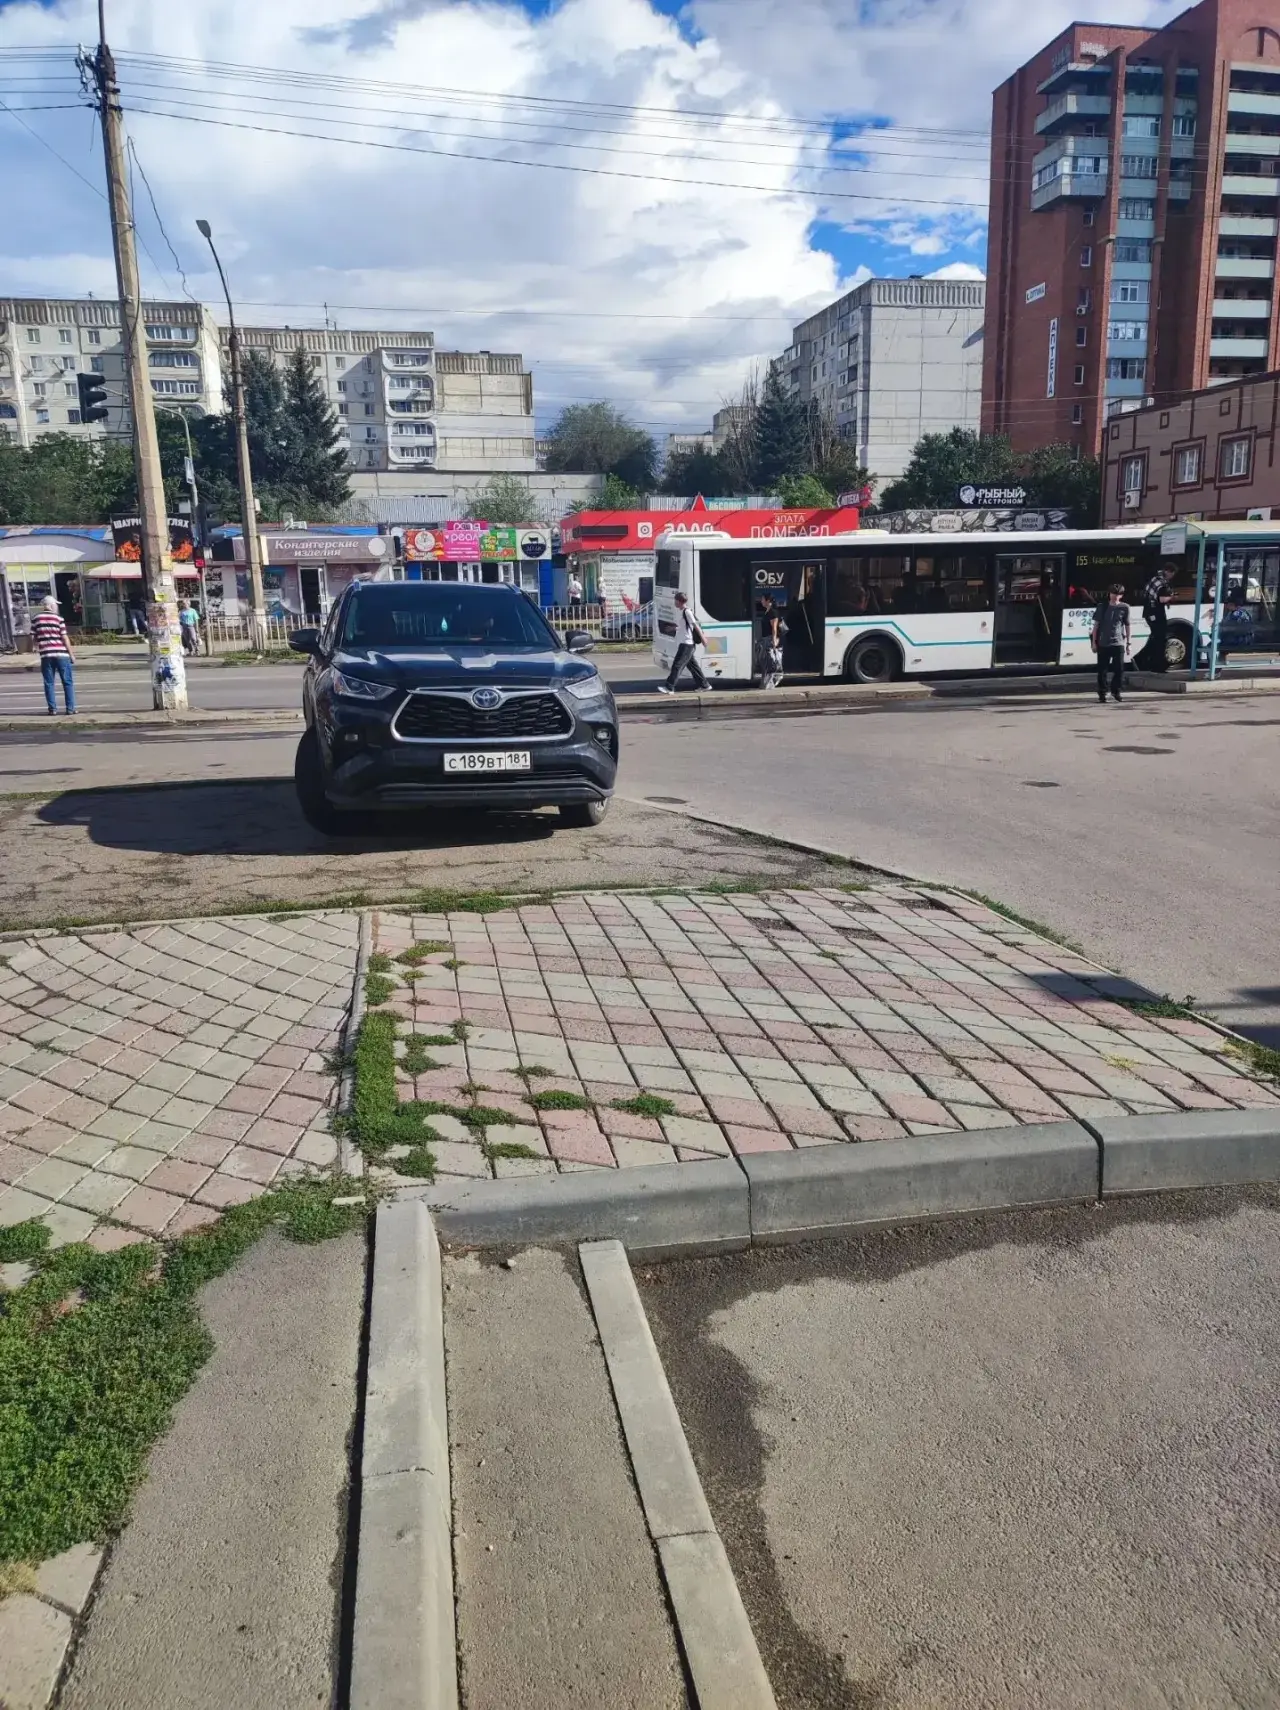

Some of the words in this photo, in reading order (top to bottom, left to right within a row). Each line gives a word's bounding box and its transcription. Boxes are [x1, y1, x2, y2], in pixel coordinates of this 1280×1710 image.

[1049, 321, 1057, 394] АПТЕКА
[979, 486, 1023, 498] РЫБНЫЙ
[774, 515, 805, 523] ЗЛАТА
[507, 753, 528, 763] 181
